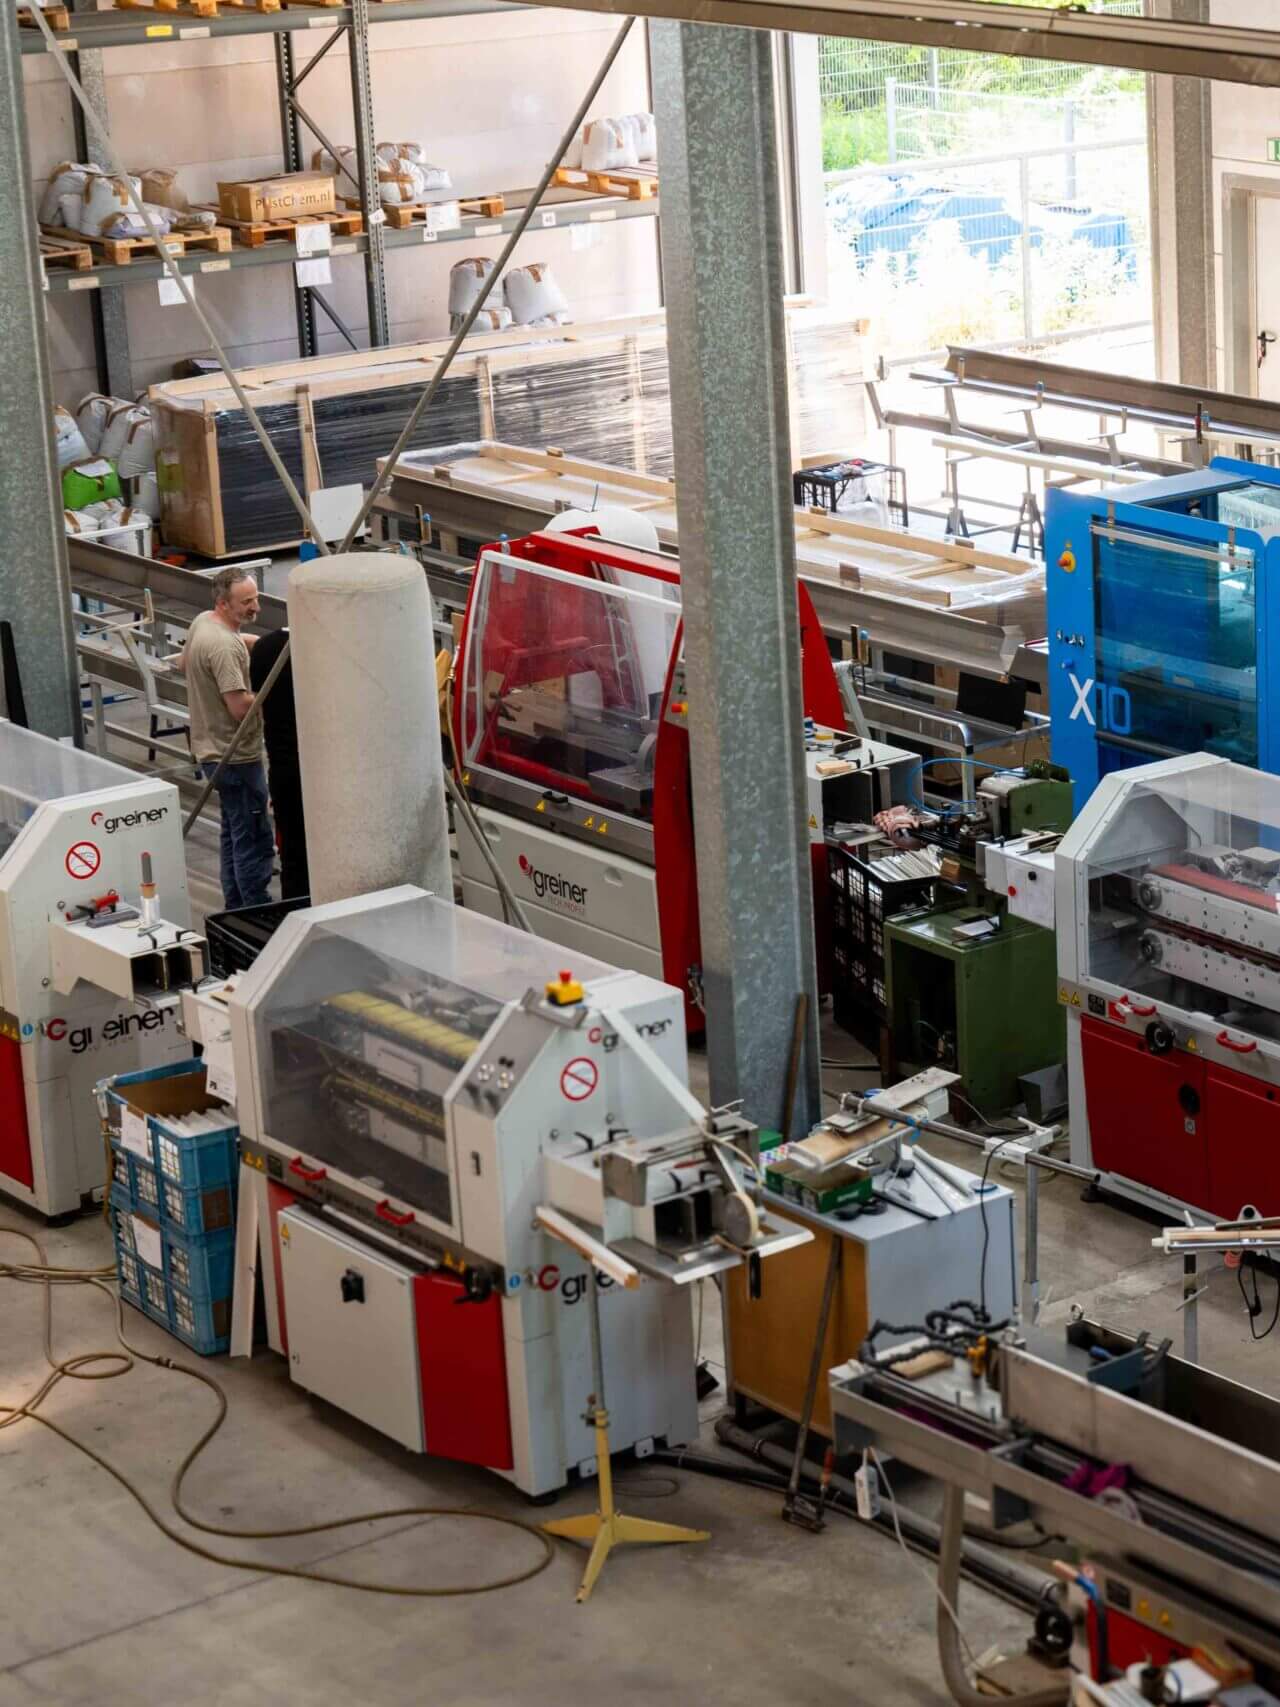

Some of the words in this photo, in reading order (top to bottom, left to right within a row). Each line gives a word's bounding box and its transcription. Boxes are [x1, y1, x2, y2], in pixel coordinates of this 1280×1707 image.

[1068, 672, 1131, 736] X10
[104, 806, 168, 834] greiner
[533, 869, 589, 905] greiner
